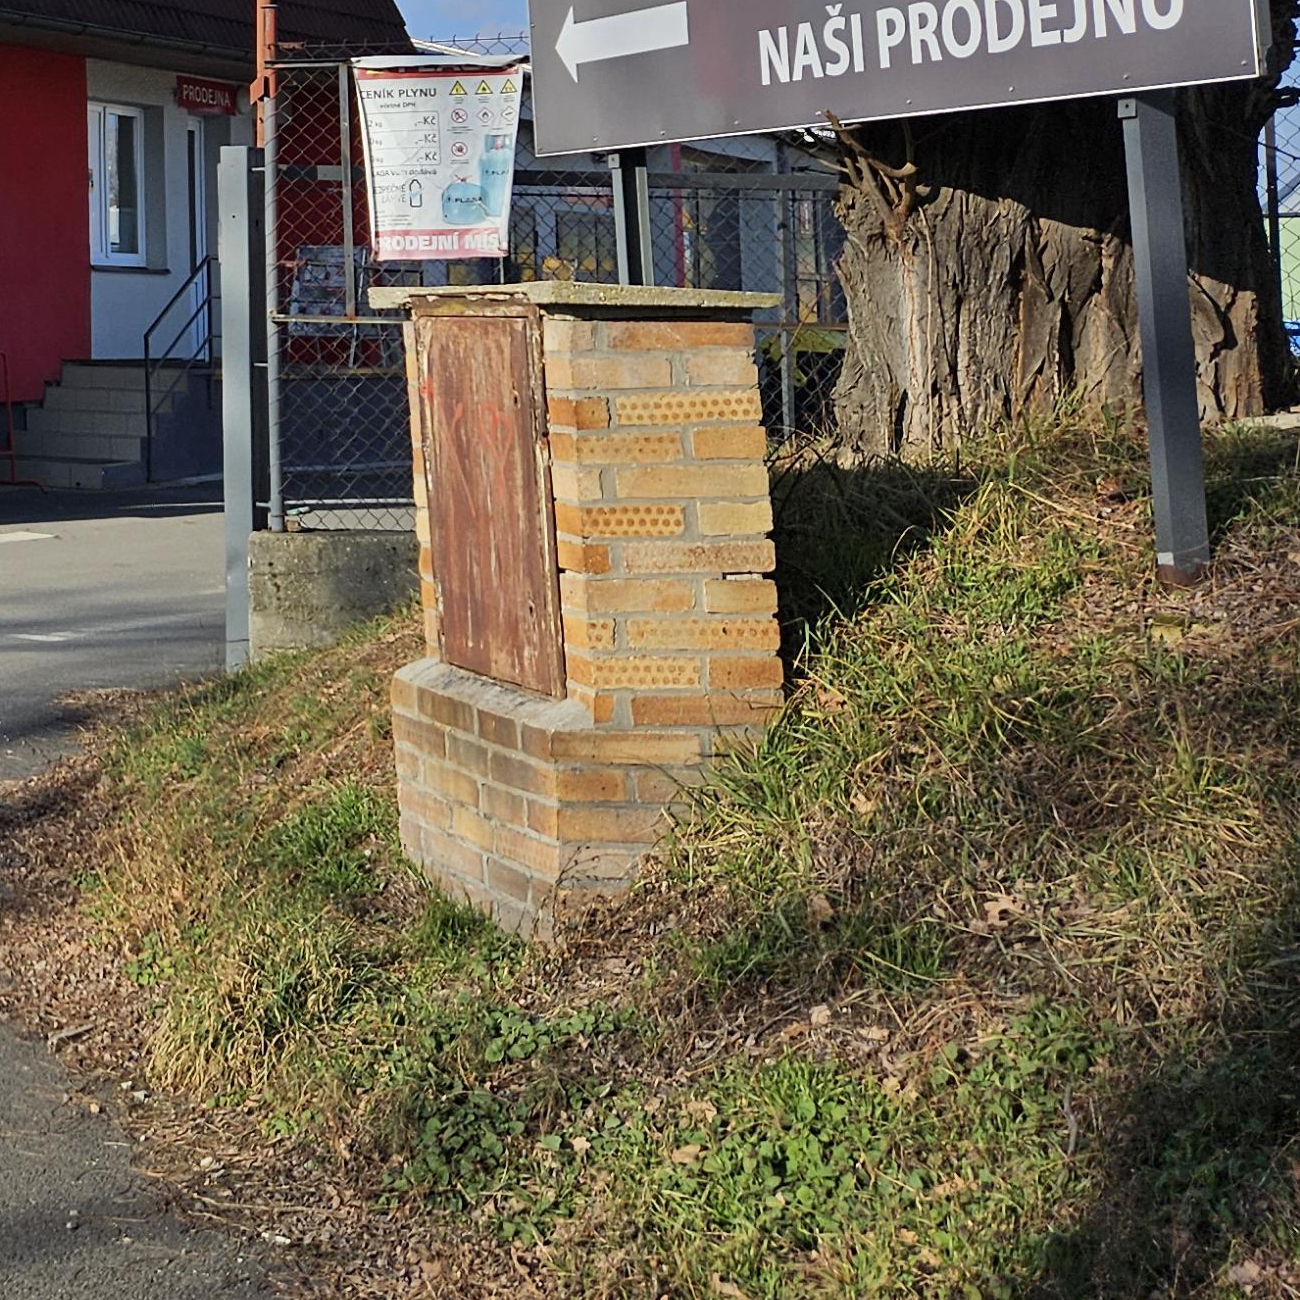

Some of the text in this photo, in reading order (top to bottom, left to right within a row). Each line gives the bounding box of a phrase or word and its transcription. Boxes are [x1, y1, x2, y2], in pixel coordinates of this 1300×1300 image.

[758, 6, 864, 86] NAŠI
[182, 84, 231, 107] PRODEJNA
[398, 87, 437, 98] PLYNU
[380, 231, 459, 251] RODEJNÍ
